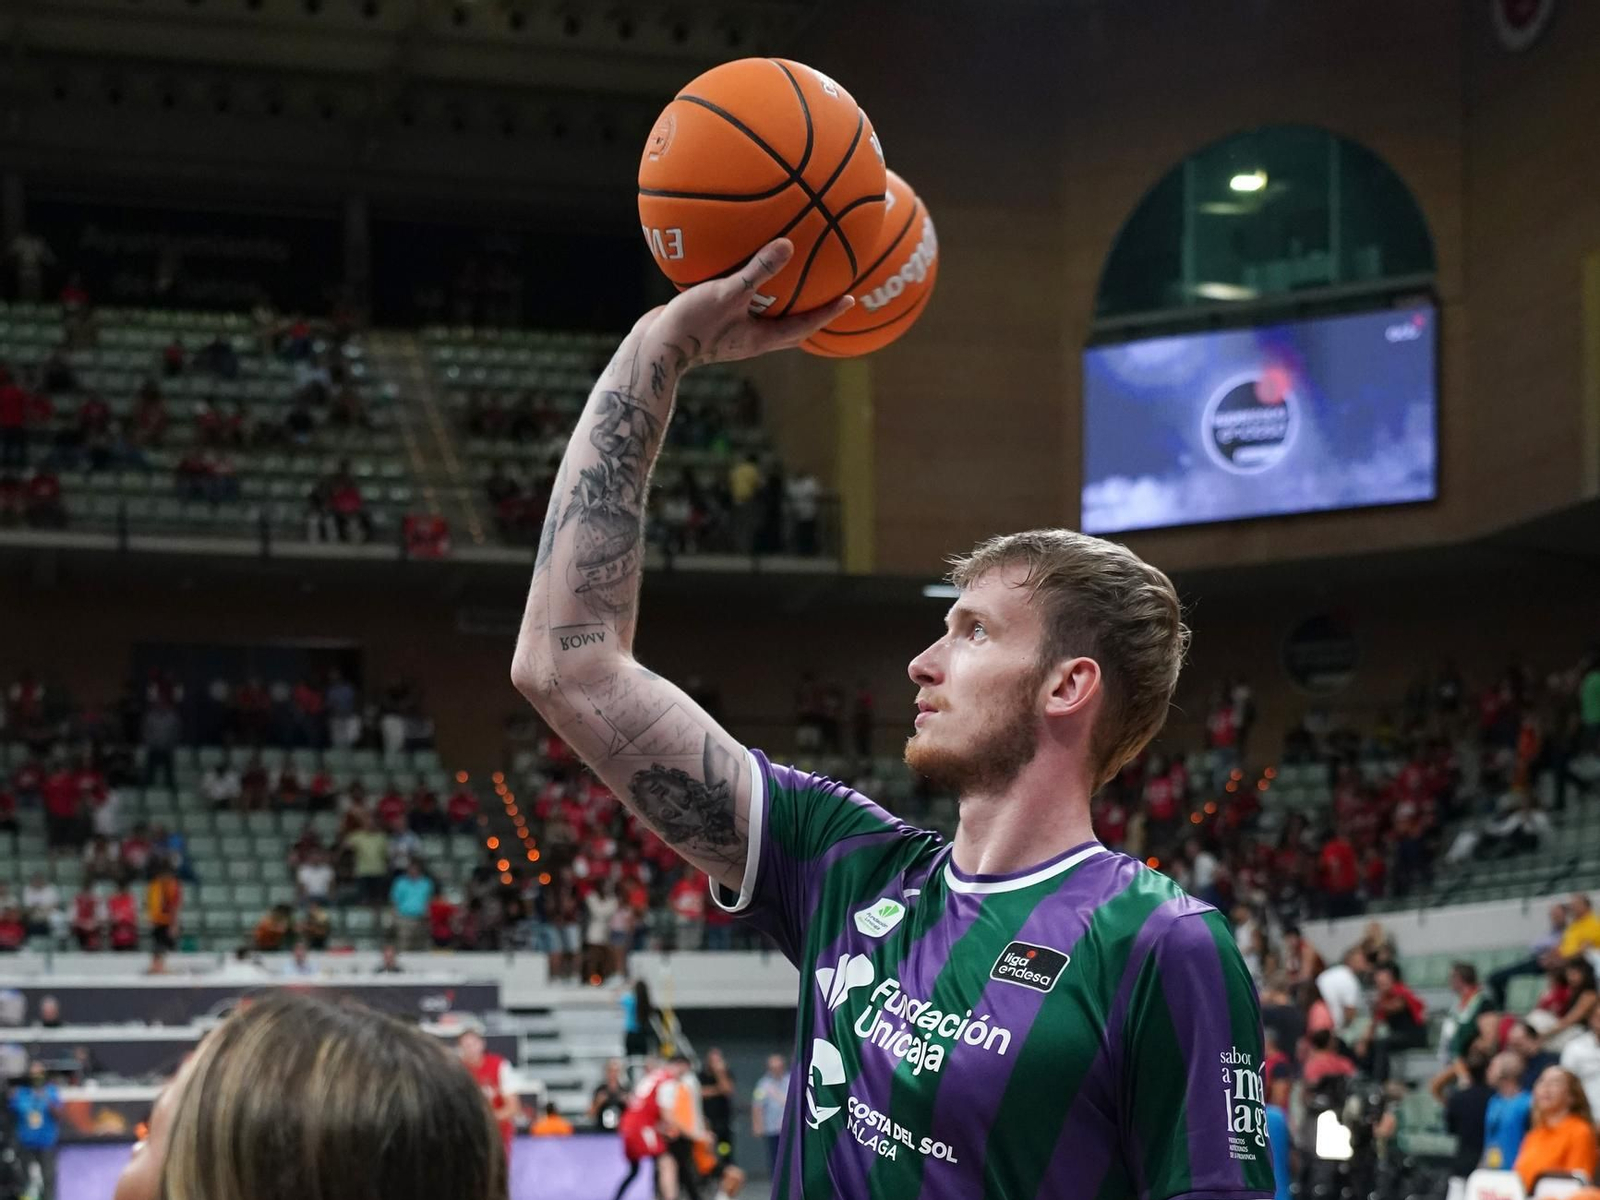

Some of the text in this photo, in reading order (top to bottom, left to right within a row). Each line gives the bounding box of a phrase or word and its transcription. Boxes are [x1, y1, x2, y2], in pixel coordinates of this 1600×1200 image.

[998, 965, 1051, 986] endesa
[1003, 952, 1030, 967] liga
[854, 1005, 945, 1076] Unicaja
[870, 977, 1012, 1056] Fundación
[847, 1096, 958, 1164] COSTA DEL SOL
